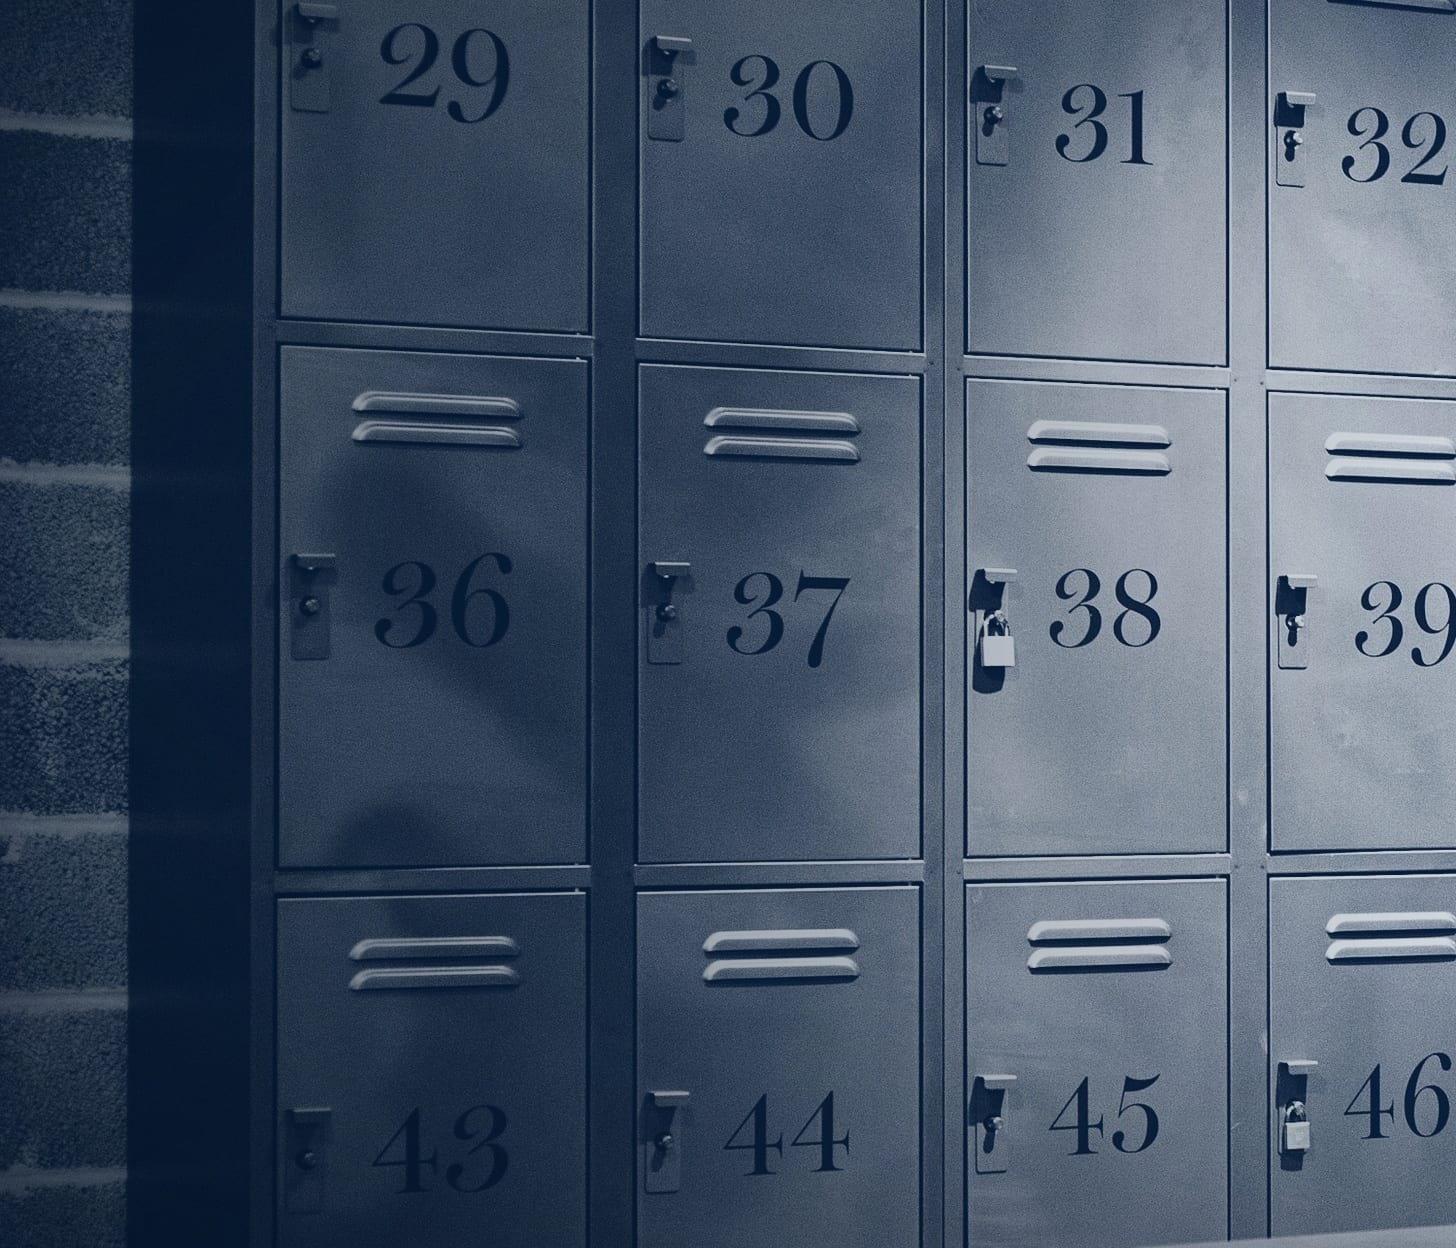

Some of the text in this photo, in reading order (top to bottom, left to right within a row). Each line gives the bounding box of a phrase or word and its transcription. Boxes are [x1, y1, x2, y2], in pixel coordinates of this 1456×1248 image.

[379, 24, 510, 123] 29
[724, 55, 853, 141] 30
[1055, 84, 1153, 166] 31
[1342, 108, 1446, 185] 32
[375, 553, 512, 648] 36
[726, 569, 850, 668] 37
[1049, 569, 1160, 648] 38
[723, 1091, 849, 1176] 44
[1049, 1075, 1159, 1155] 45
[1344, 1053, 1453, 1139] 46
[372, 1104, 509, 1194] 43
